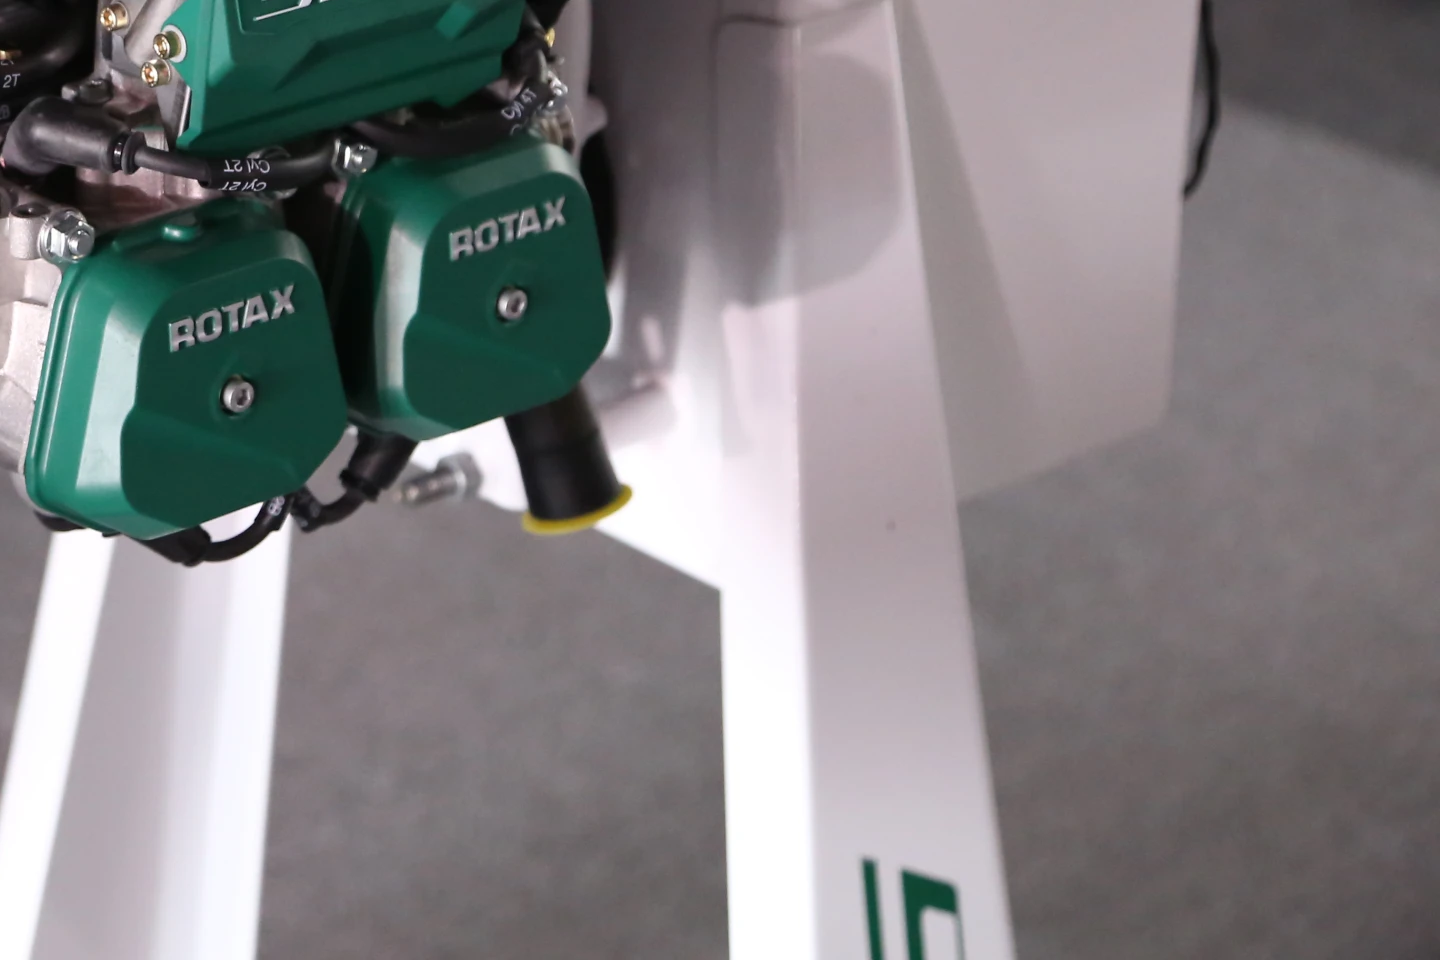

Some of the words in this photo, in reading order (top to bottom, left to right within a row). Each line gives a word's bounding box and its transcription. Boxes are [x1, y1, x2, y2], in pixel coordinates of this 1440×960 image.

[2, 73, 21, 88] 2T
[223, 159, 243, 172] 2T
[246, 158, 270, 174] Cyl
[218, 181, 242, 191] 2T
[241, 178, 267, 192] Cyl
[449, 196, 567, 262] ROTAX
[168, 283, 296, 354] ROTAX
